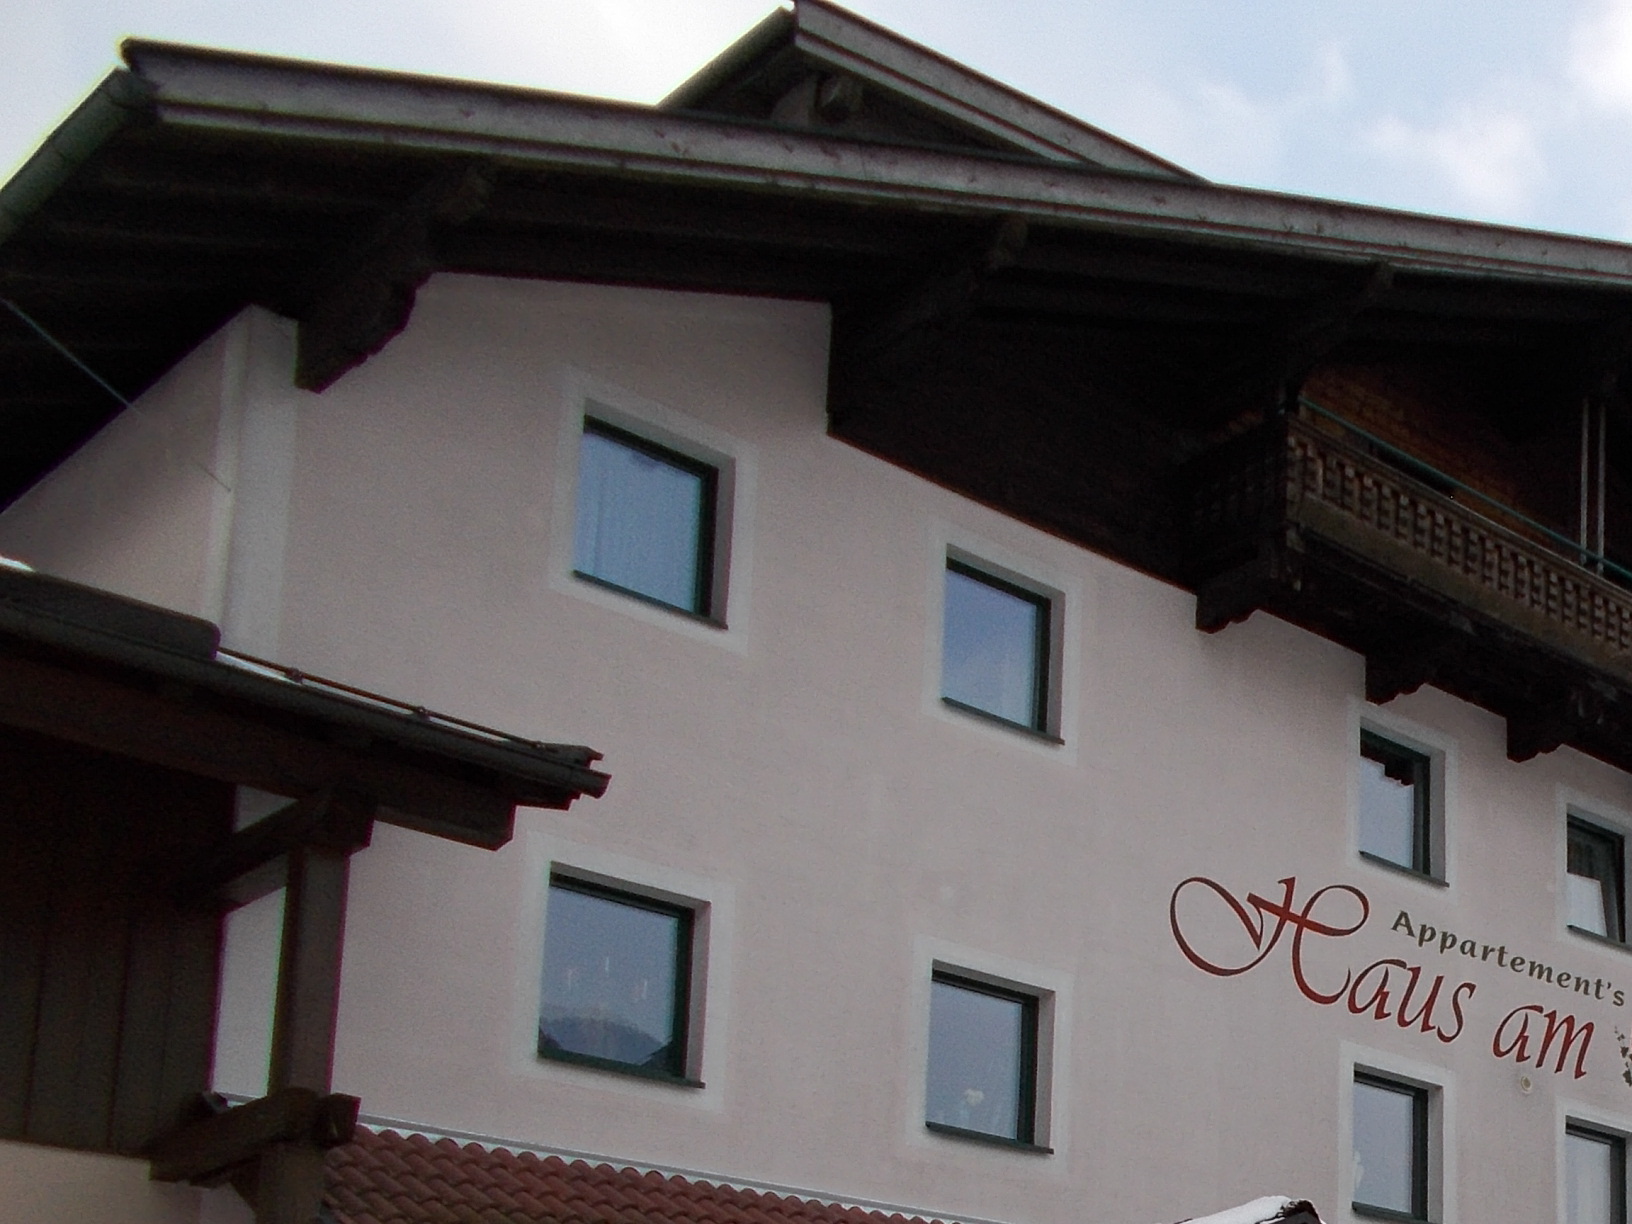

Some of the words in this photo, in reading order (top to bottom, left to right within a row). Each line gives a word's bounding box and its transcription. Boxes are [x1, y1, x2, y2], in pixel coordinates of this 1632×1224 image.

[1170, 876, 1477, 1043] Haus
[1492, 1003, 1595, 1079] am
[1391, 910, 1625, 1007] Appartement's
